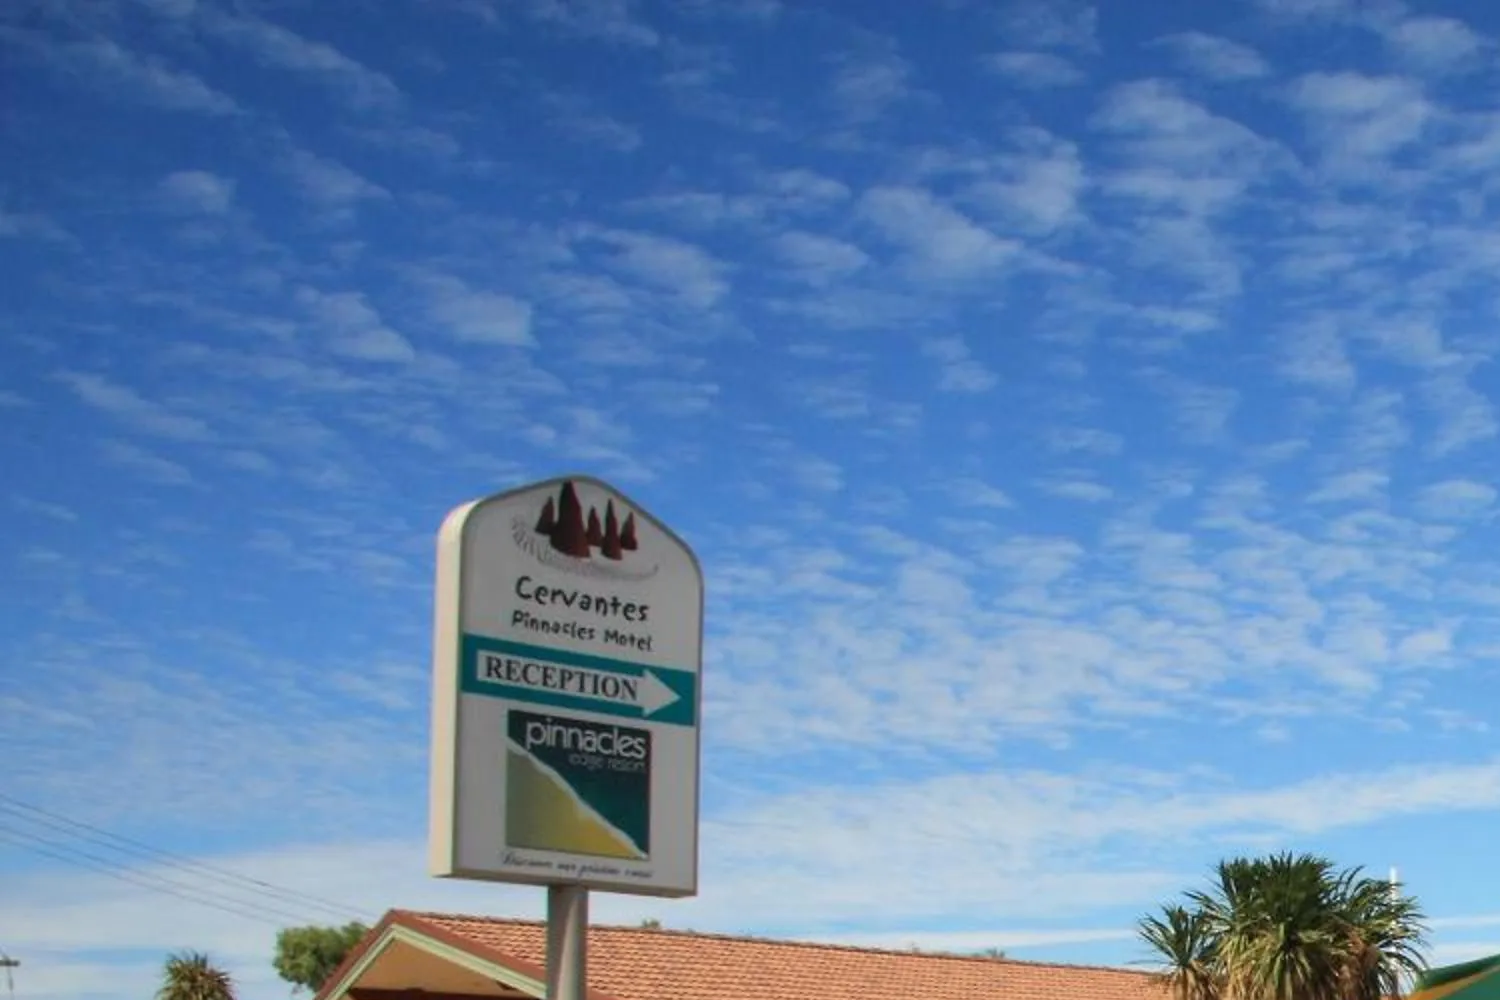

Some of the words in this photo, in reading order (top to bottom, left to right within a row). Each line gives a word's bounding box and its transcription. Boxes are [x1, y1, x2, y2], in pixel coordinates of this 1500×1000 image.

[515, 575, 650, 622] Cervantes
[603, 629, 654, 652] Motel
[484, 655, 638, 701] RECEPTION
[525, 717, 646, 760] pinnacles
